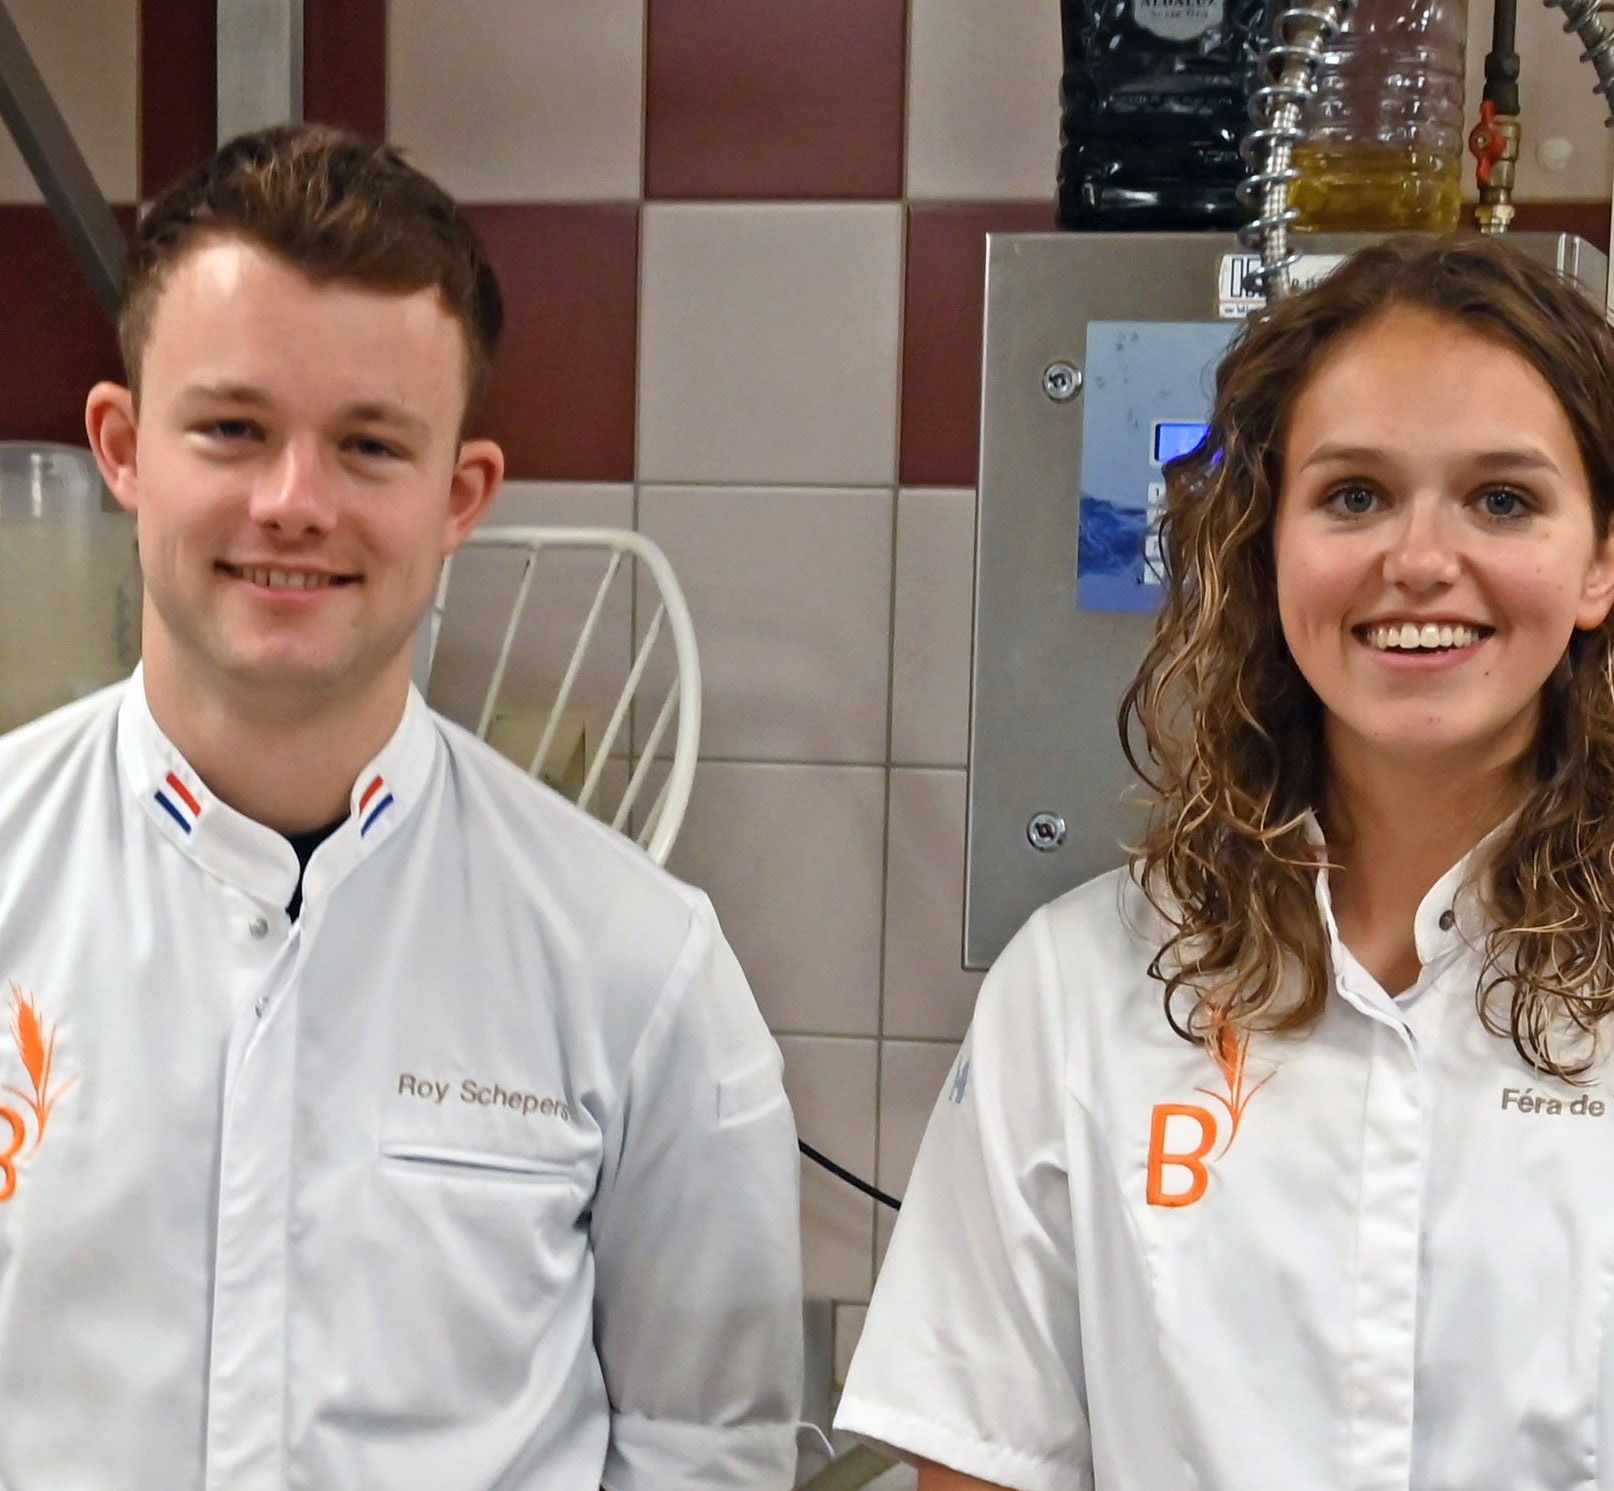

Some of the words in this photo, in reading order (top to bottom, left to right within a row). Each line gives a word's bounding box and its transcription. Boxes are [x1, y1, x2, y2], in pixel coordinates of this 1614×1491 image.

[398, 1073, 450, 1103] Roy
[460, 1079, 570, 1121] Schepers
[1501, 1087, 1563, 1116] Féra
[1570, 1094, 1605, 1117] de
[1146, 1104, 1218, 1208] B
